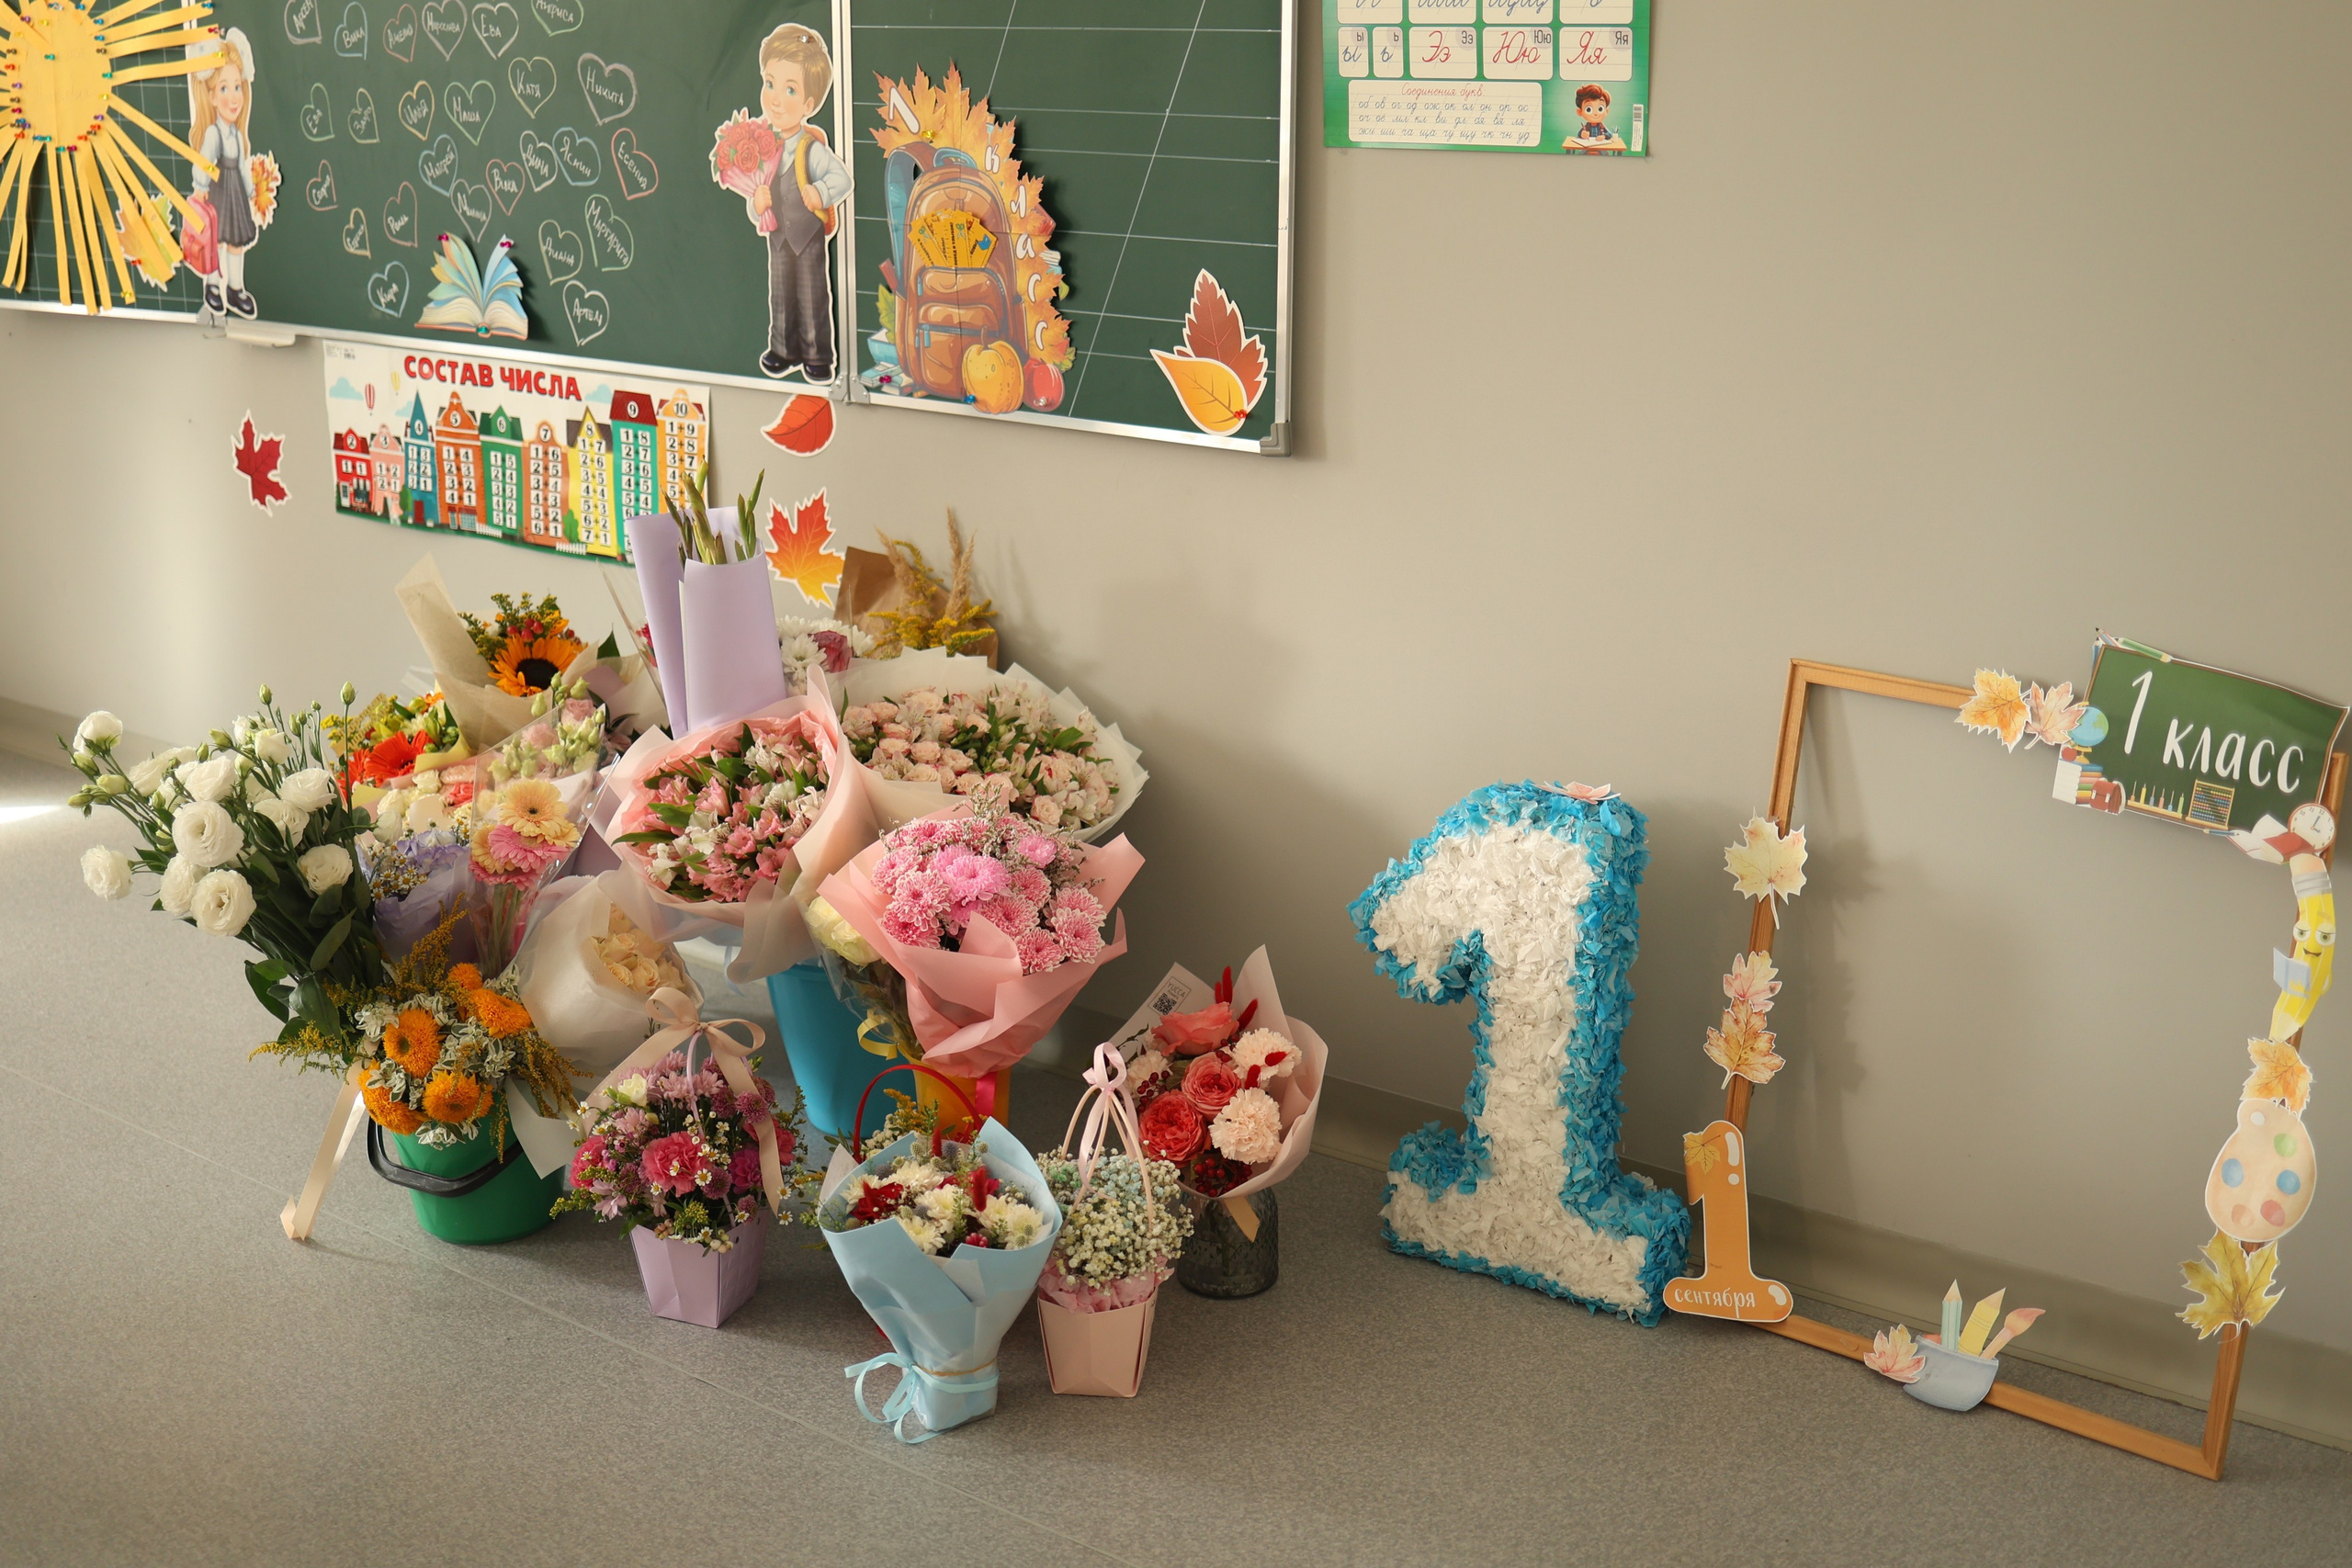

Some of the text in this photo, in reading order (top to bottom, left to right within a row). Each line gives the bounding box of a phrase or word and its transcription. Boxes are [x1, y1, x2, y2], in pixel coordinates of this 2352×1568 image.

[481, 14, 502, 38] Ева
[1356, 32, 1364, 42] ы
[1393, 32, 1400, 42] ь
[1461, 30, 1474, 44] Ээ
[1533, 29, 1552, 44] Юю
[1615, 31, 1629, 45] Яя
[1342, 46, 1362, 62] ы
[1380, 46, 1393, 62] ь
[1421, 30, 1451, 62] Ээ
[1492, 30, 1541, 63] Юю
[1566, 30, 1607, 64] Яя
[516, 68, 541, 98] Катя
[586, 66, 624, 106] Никита
[1401, 82, 1457, 100] Соединения
[453, 96, 481, 123] Маша
[618, 141, 648, 190] Есения
[586, 199, 629, 265] Маргарита
[404, 355, 582, 401] СОСТАВ ЧИСЛА
[629, 403, 637, 415] 9
[675, 404, 688, 415] 10
[451, 414, 458, 424] 5
[498, 420, 504, 430] 6
[416, 423, 423, 432] 4
[542, 428, 548, 439] 7
[586, 424, 594, 435] 8
[348, 438, 356, 446] 2
[381, 435, 388, 445] 3
[2124, 671, 2304, 793] 1 класс
[1168, 982, 1186, 998] YUCCA
[1674, 1287, 1756, 1319] сентября
